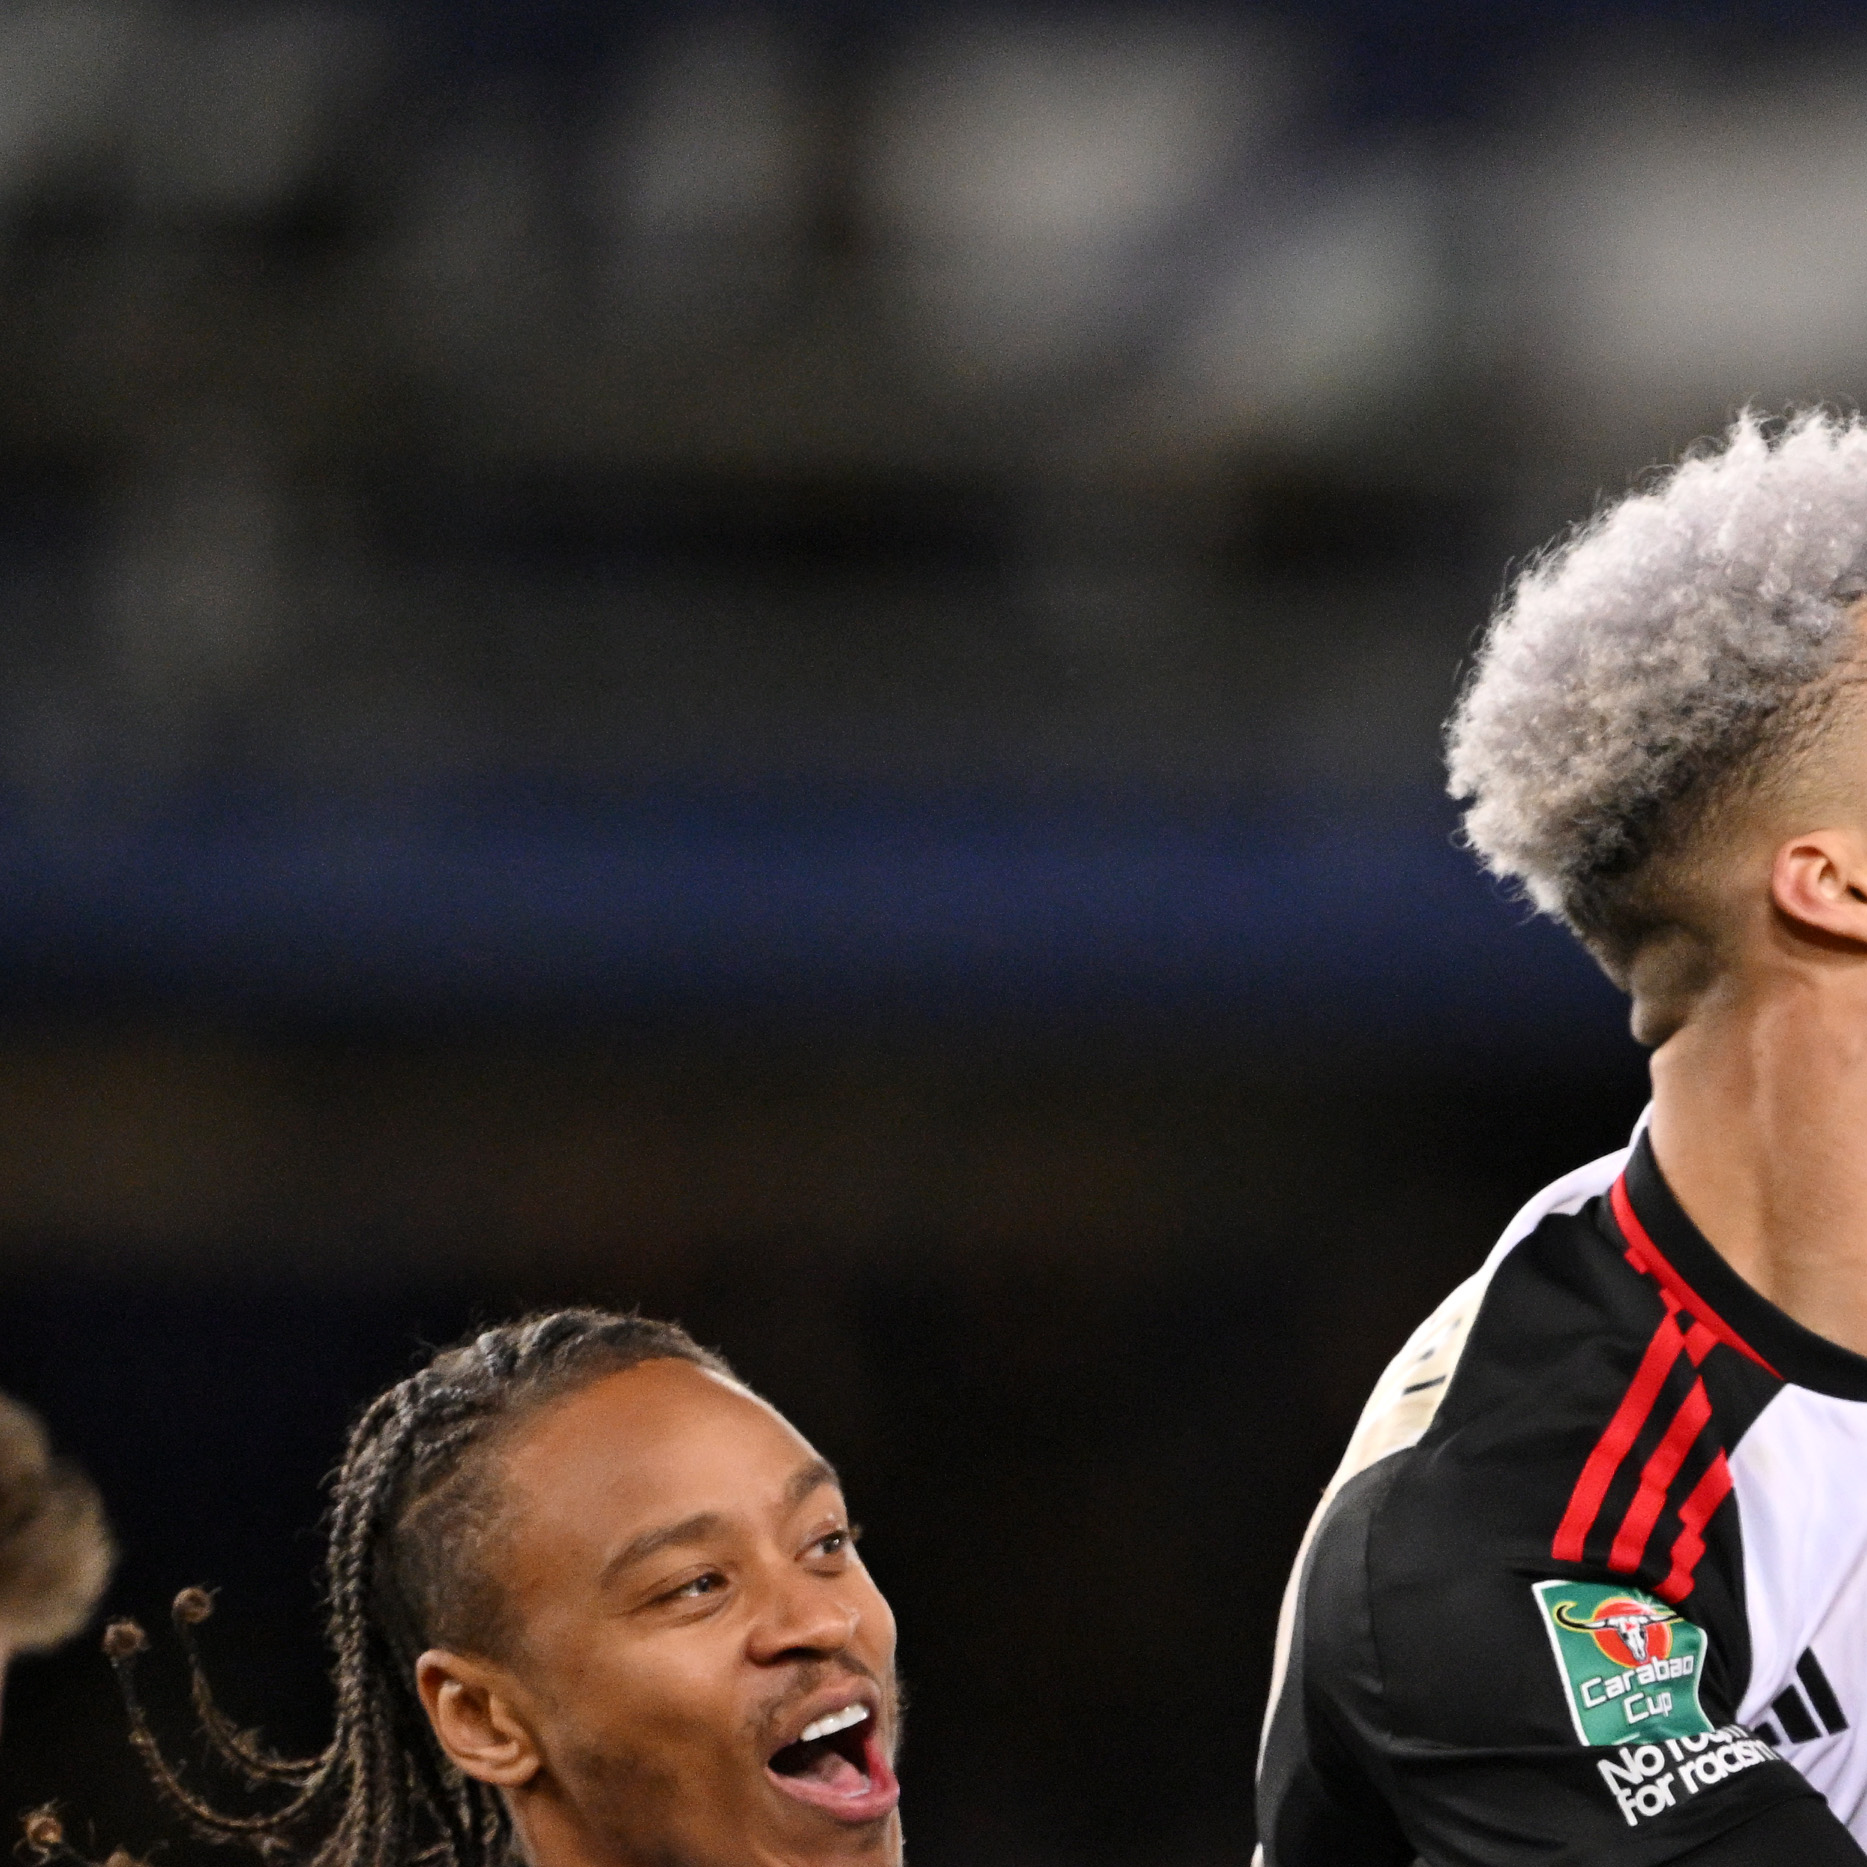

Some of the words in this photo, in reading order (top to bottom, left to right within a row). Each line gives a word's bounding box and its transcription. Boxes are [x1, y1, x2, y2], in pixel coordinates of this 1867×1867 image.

[1580, 1654, 1695, 1709] Carabao
[1623, 1692, 1673, 1724] Cup
[1597, 1743, 1665, 1797] No
[1617, 1774, 1676, 1826] for
[1678, 1738, 1781, 1794] racism
